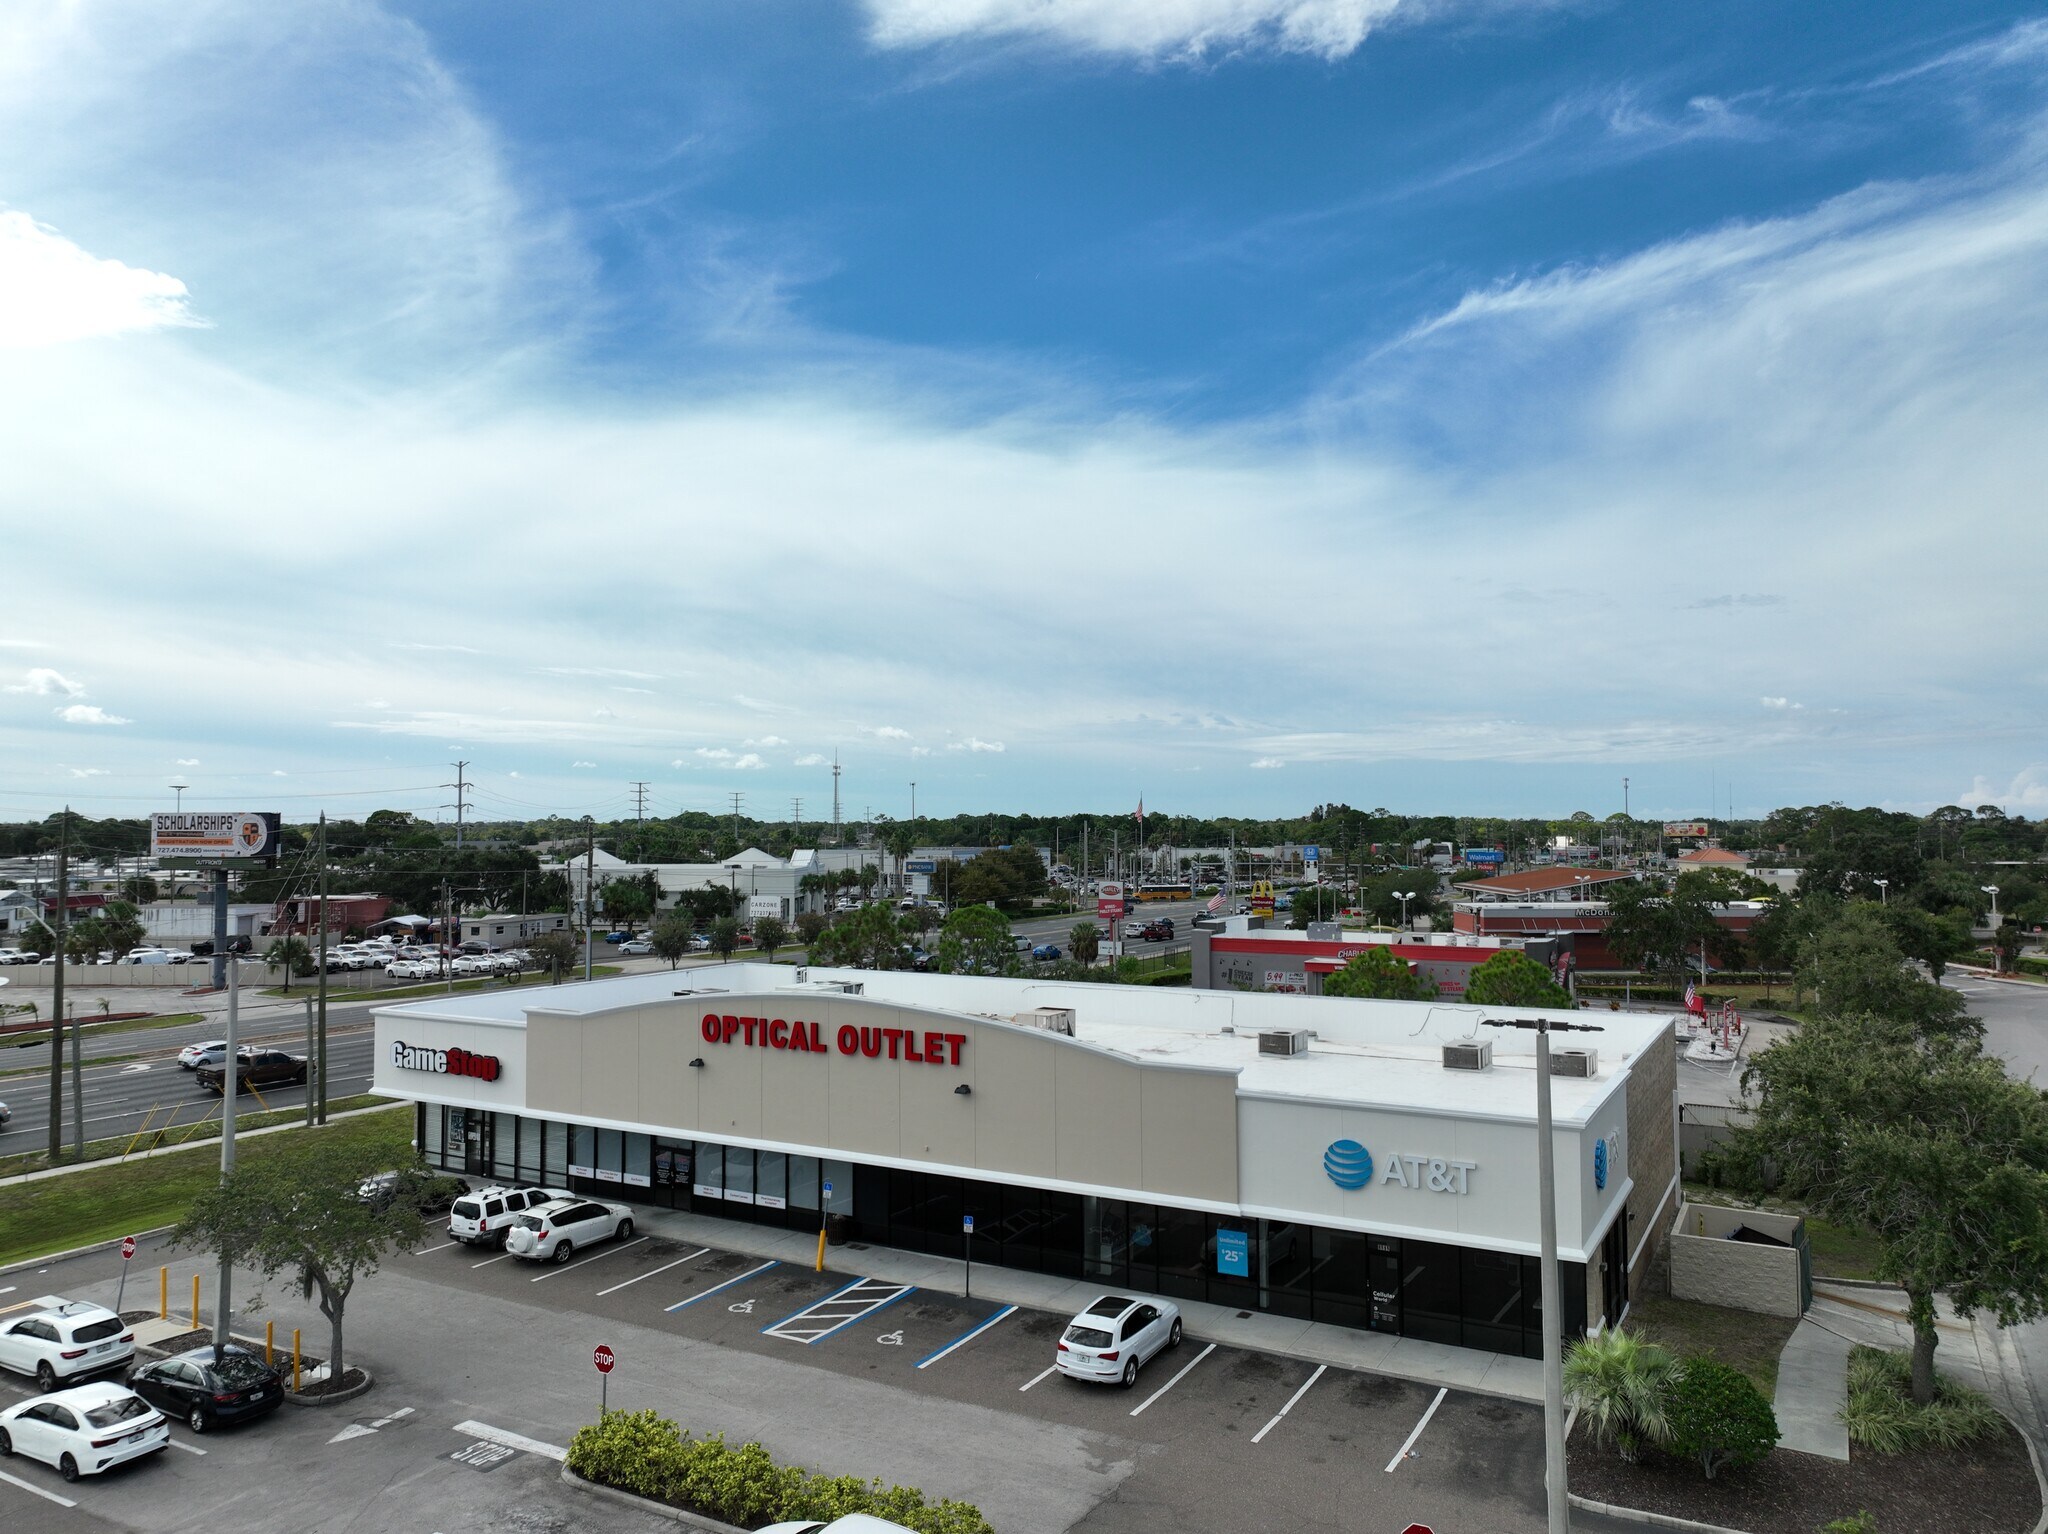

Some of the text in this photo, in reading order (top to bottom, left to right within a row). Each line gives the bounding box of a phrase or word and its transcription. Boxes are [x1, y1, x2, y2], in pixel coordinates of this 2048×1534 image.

[157, 815, 233, 830] SCHOLARSHIPS
[1266, 972, 1284, 981] 5.99
[701, 1013, 967, 1066] OPTICAL OUTLET
[390, 1040, 500, 1082] GameStop
[1380, 1153, 1477, 1195] AT&T
[122, 1242, 135, 1253] STOP
[1372, 1290, 1396, 1299] Cellular
[595, 1352, 614, 1366] STOP
[450, 1440, 515, 1467] STOP
